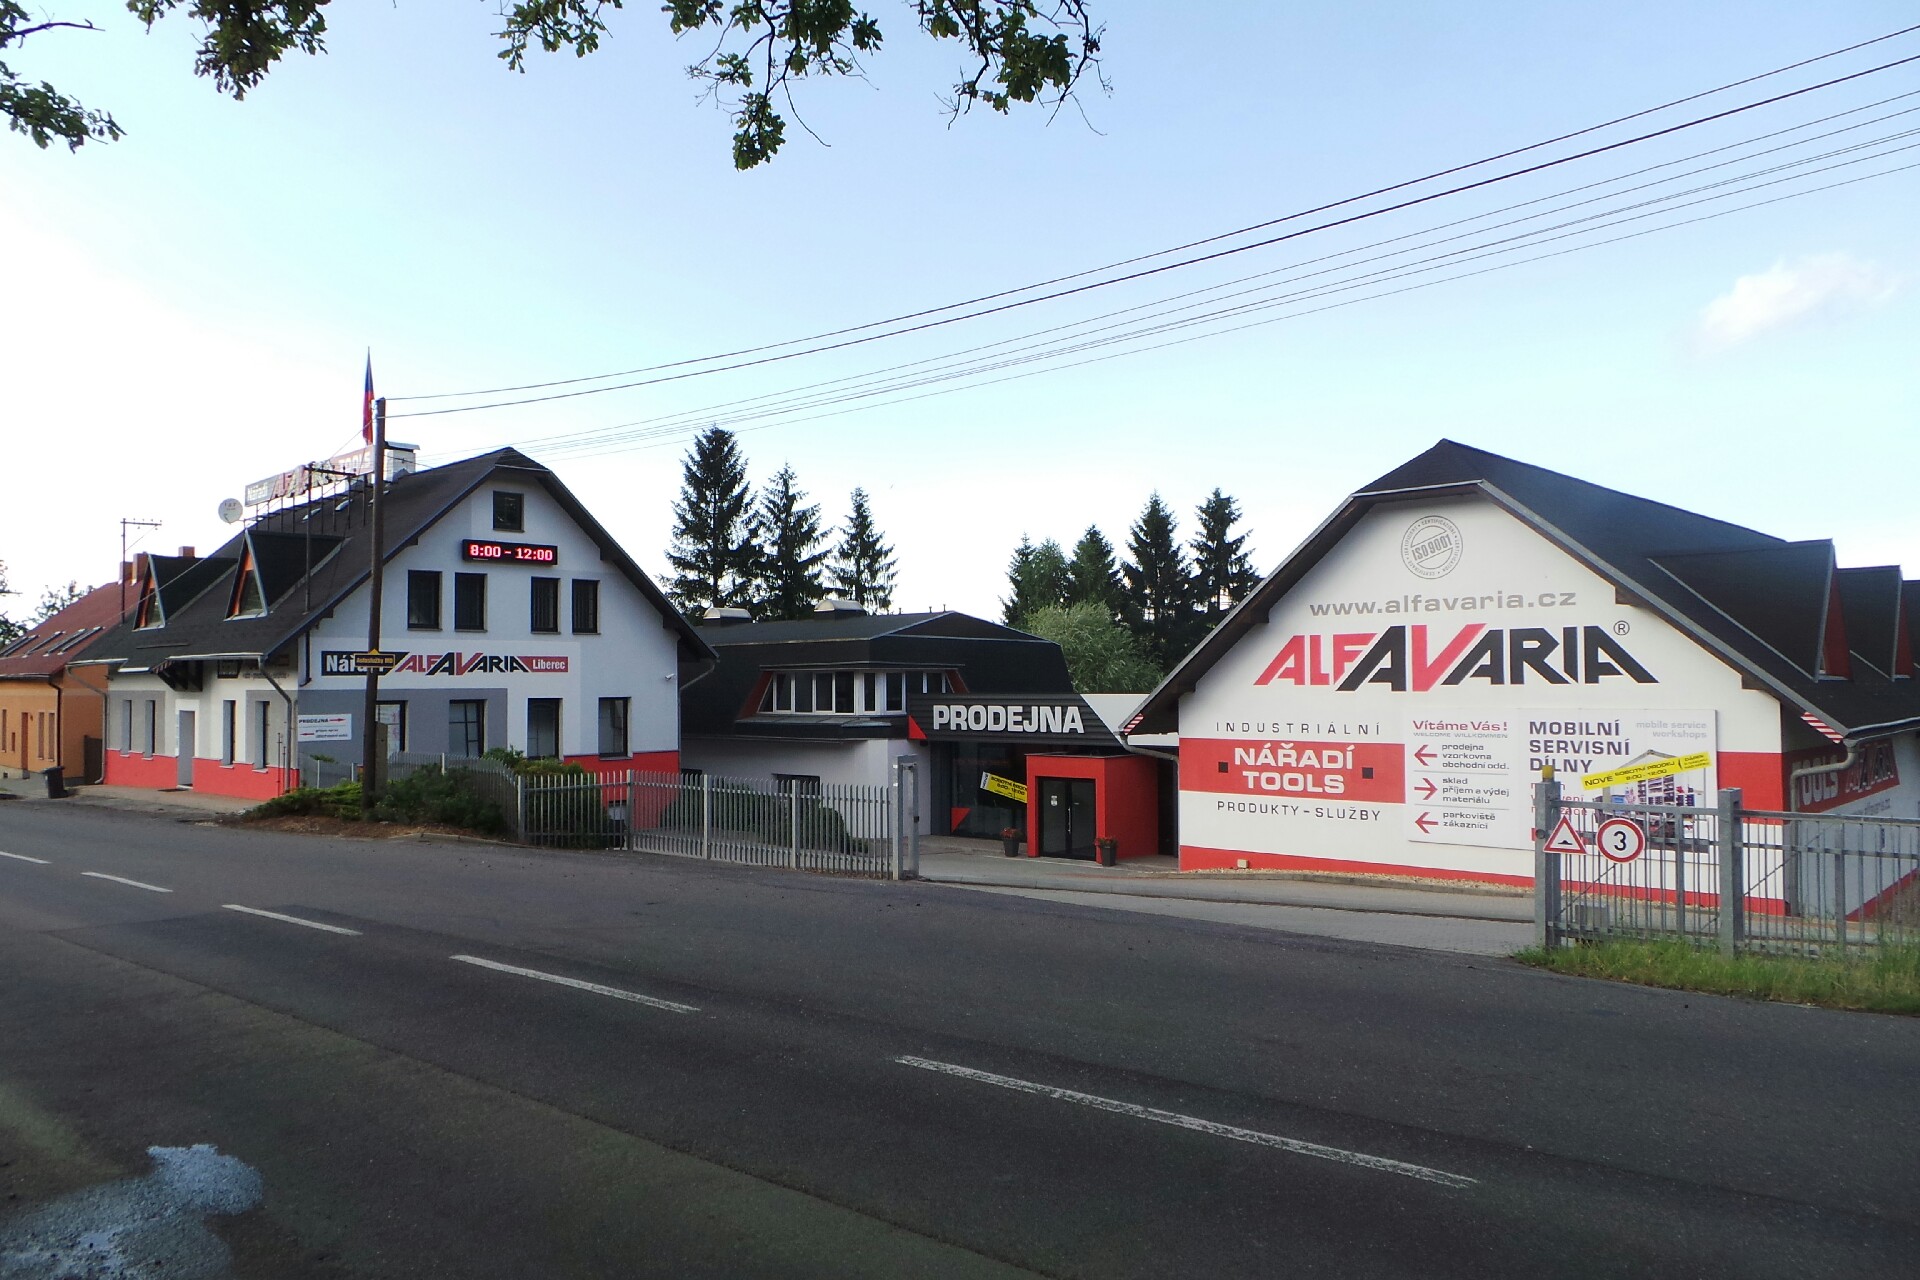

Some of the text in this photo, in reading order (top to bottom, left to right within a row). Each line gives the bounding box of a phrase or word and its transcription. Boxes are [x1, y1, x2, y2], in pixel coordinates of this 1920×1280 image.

[470, 543, 501, 558] 8:00
[515, 547, 553, 561] 12:00
[1309, 590, 1577, 616] www.alfavaria.cz
[395, 652, 529, 676] ALFAVARIA
[532, 658, 566, 670] Liberec
[1253, 623, 1660, 692] ALFAVARIA
[932, 704, 1085, 734] PRODEJNA
[1413, 720, 1468, 731] Vítáme
[1636, 720, 1708, 729] mobile service
[1216, 721, 1380, 735] INDUSTRIÁLNÍ
[1529, 719, 1620, 736] MOBILNÍ
[1652, 730, 1708, 739] workshops
[1529, 738, 1630, 756] SERVISNÍ
[1234, 742, 1355, 769] NÁŘADÍ
[1442, 752, 1492, 760] vzorkovna
[1442, 761, 1486, 769] obchodní
[1242, 771, 1345, 794] TOOLS
[1442, 777, 1468, 785] sklad
[1442, 786, 1474, 794] příjem
[1483, 788, 1510, 797] výdej
[1442, 796, 1490, 804] materiálu
[1443, 812, 1496, 821] parkoviště
[1443, 820, 1488, 829] zákazníci
[1613, 831, 1627, 851] 3
